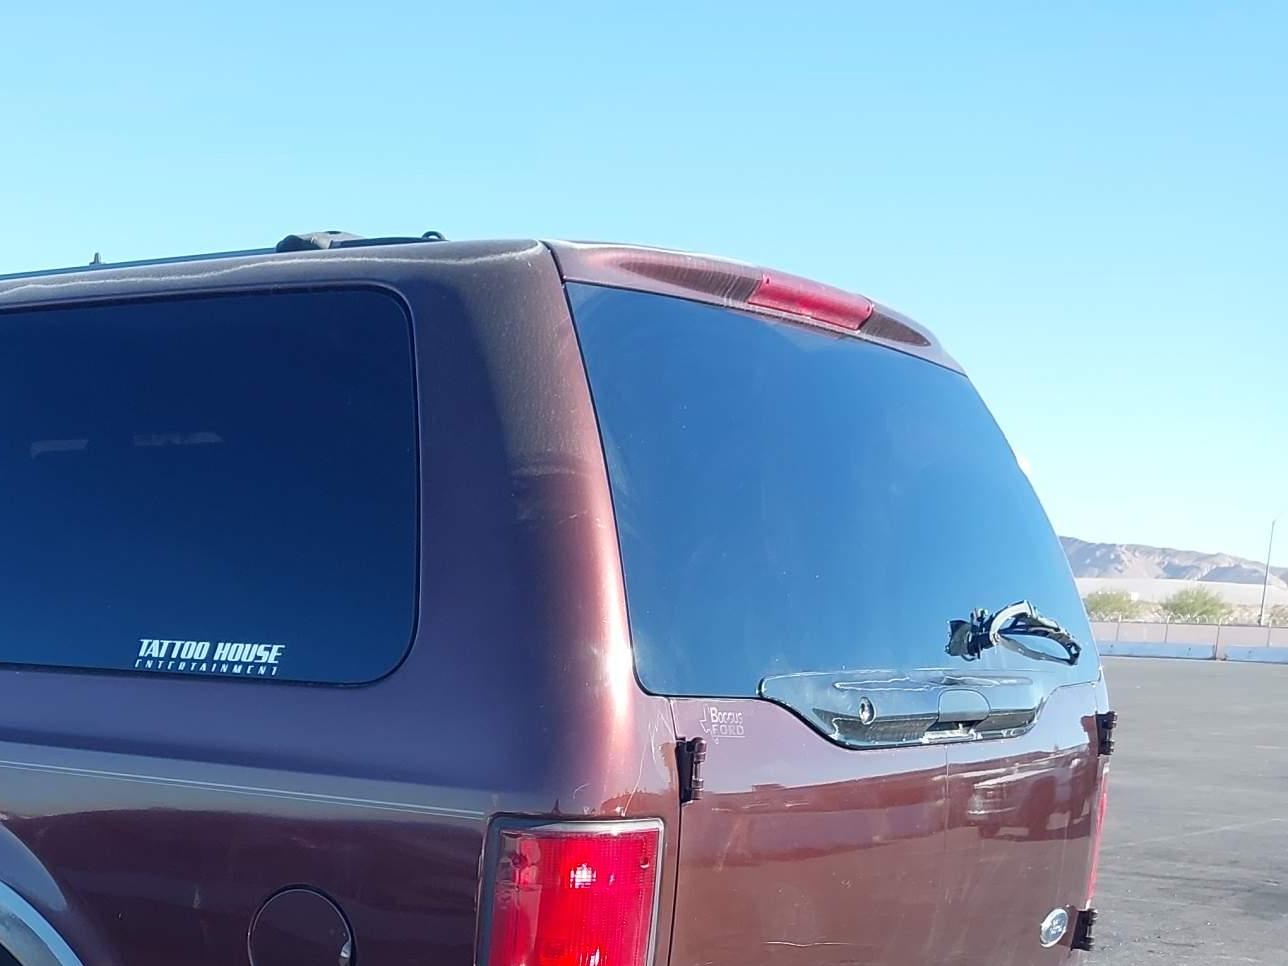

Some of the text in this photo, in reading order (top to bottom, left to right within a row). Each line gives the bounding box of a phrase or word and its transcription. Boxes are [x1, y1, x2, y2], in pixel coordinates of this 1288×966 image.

[137, 638, 286, 664] TATTOO HOUSE
[134, 659, 278, 676] ENTERTAINMENT
